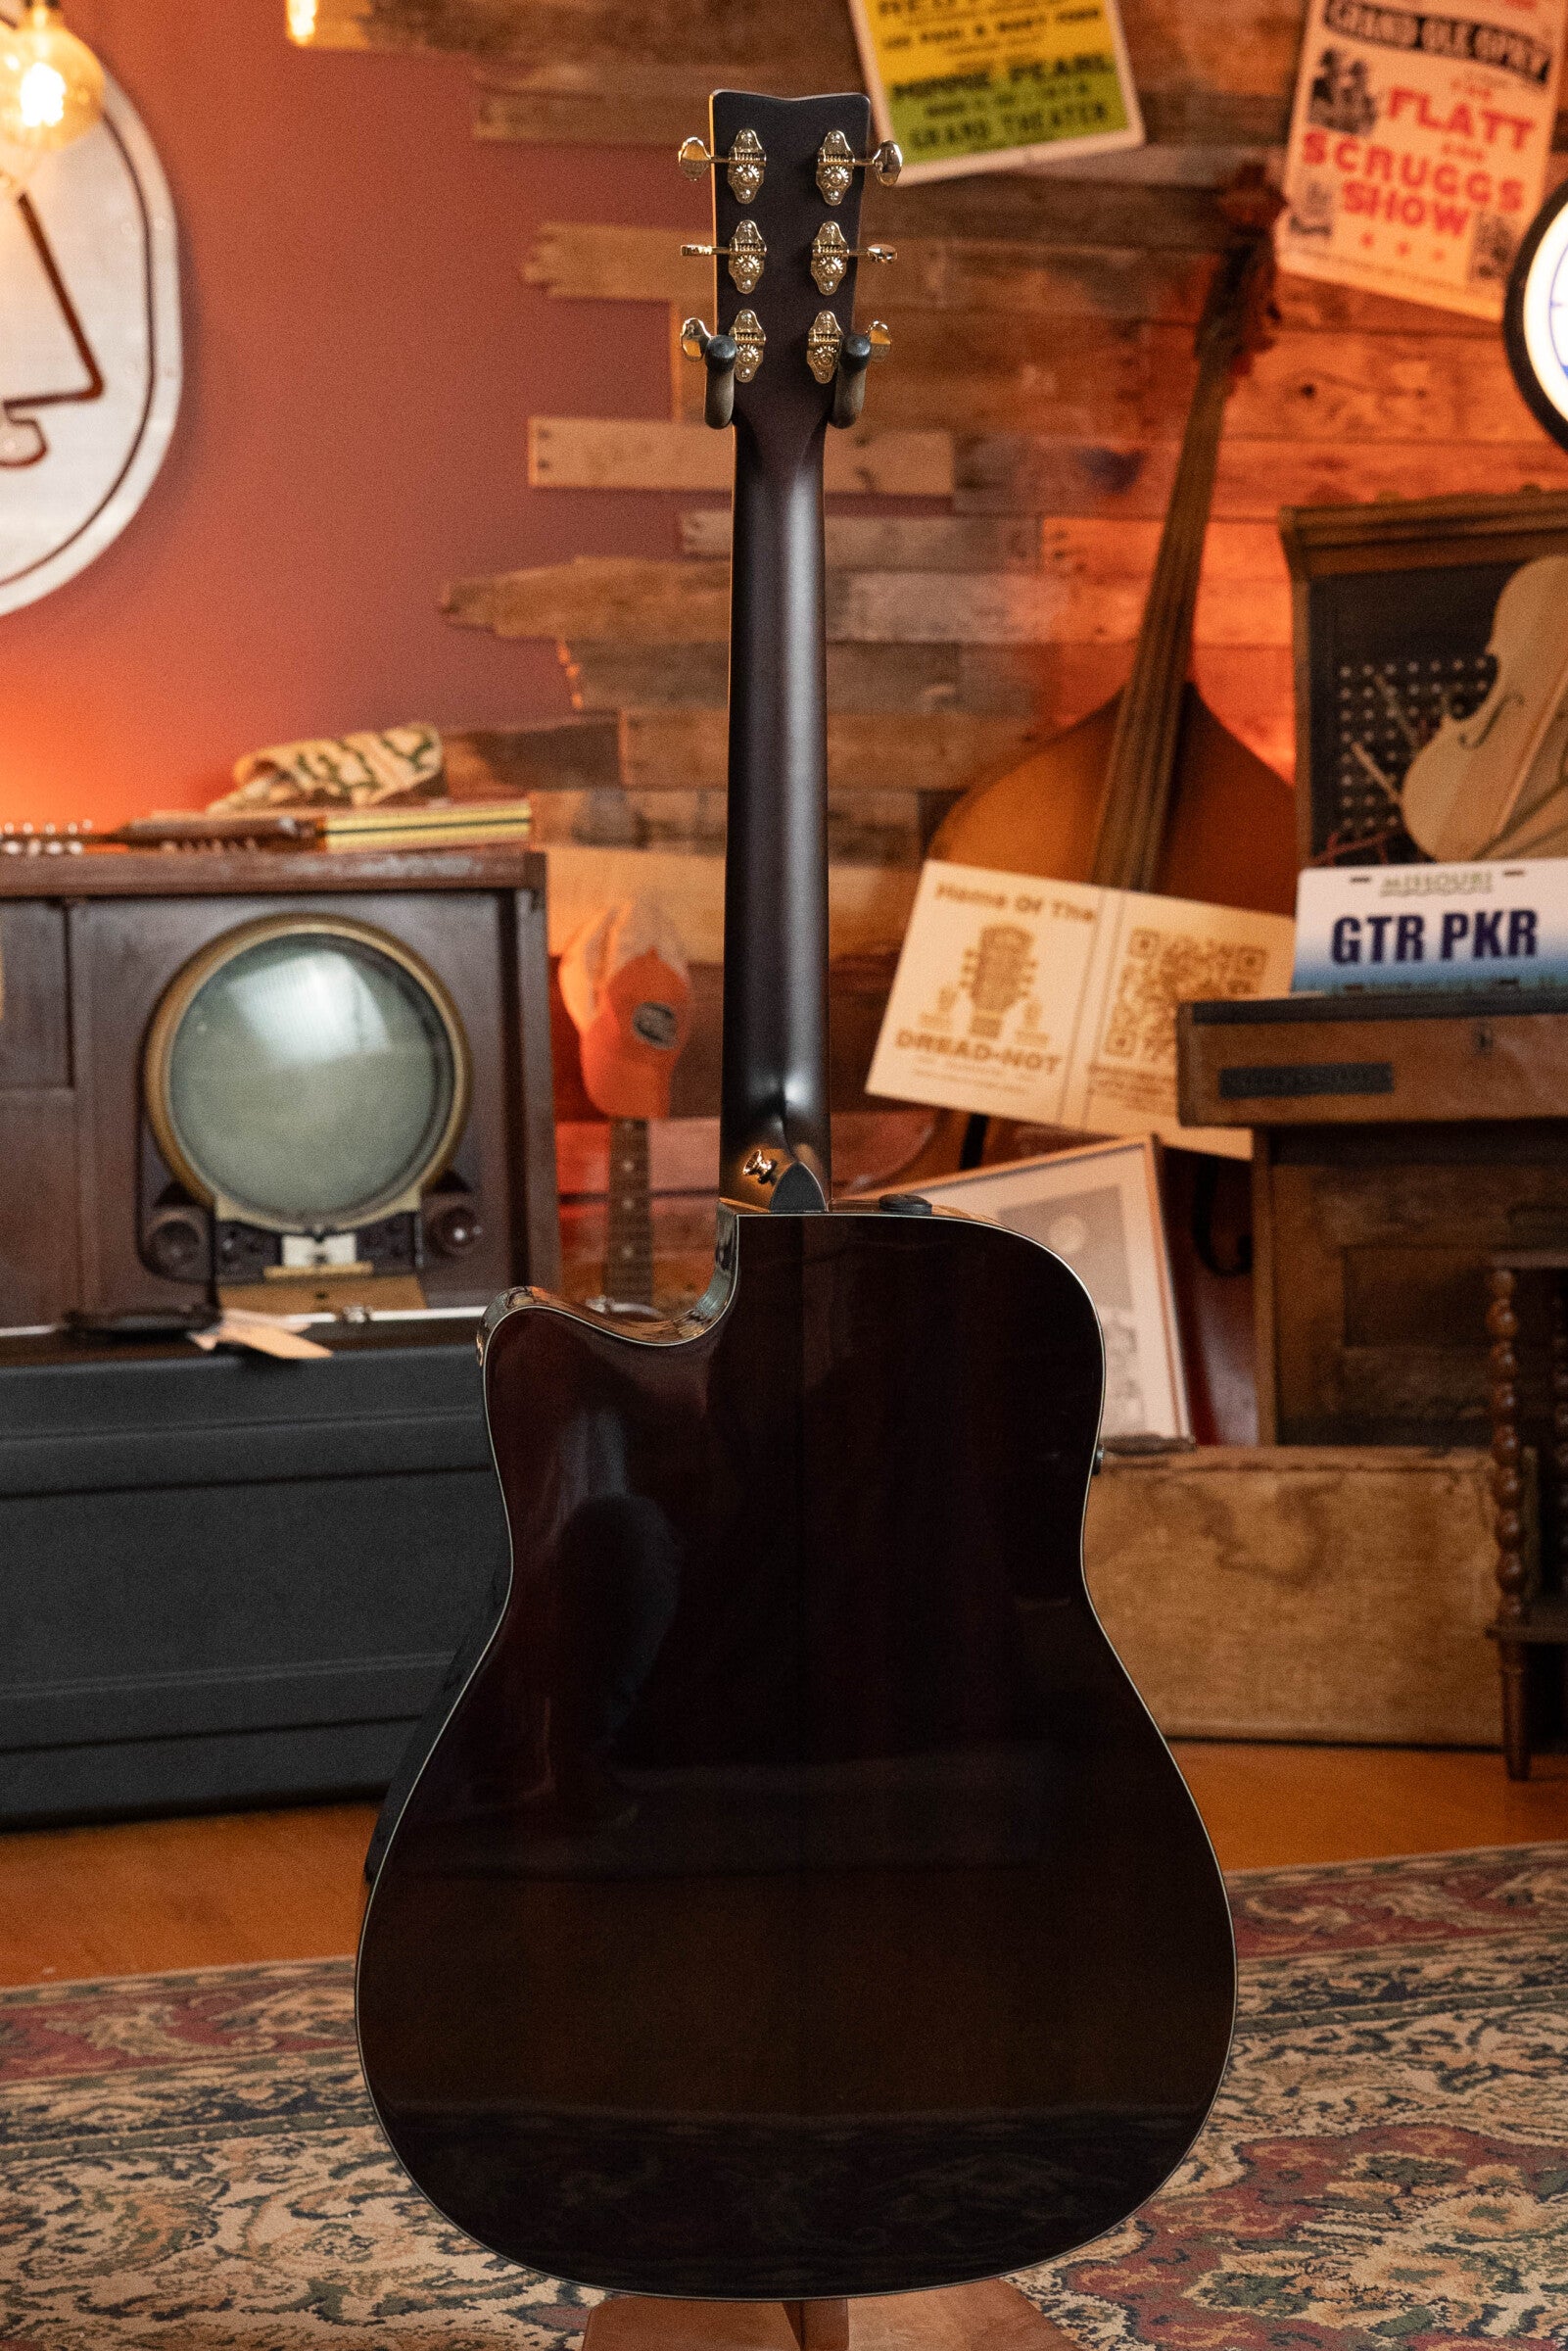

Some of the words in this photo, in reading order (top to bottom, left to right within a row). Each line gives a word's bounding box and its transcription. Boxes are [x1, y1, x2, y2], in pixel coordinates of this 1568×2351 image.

[1327, 2, 1417, 45] GRAND
[1421, 17, 1469, 53] OLE
[1474, 24, 1550, 77] OPRY
[1008, 52, 1116, 82] PEARL
[909, 118, 991, 148] GRAND
[1000, 101, 1108, 131] THEATER
[1387, 85, 1536, 151] FLATT
[1303, 130, 1524, 213] SCRUGGS
[1341, 179, 1470, 239] SHOW
[935, 882, 1007, 910] Home
[1014, 893, 1044, 916] Of
[1051, 899, 1096, 923] The
[1379, 870, 1494, 898] MISSOURI
[1331, 913, 1426, 965] GTR
[1440, 907, 1539, 961] PKR
[894, 1029, 1062, 1075] DREAD-NOT
